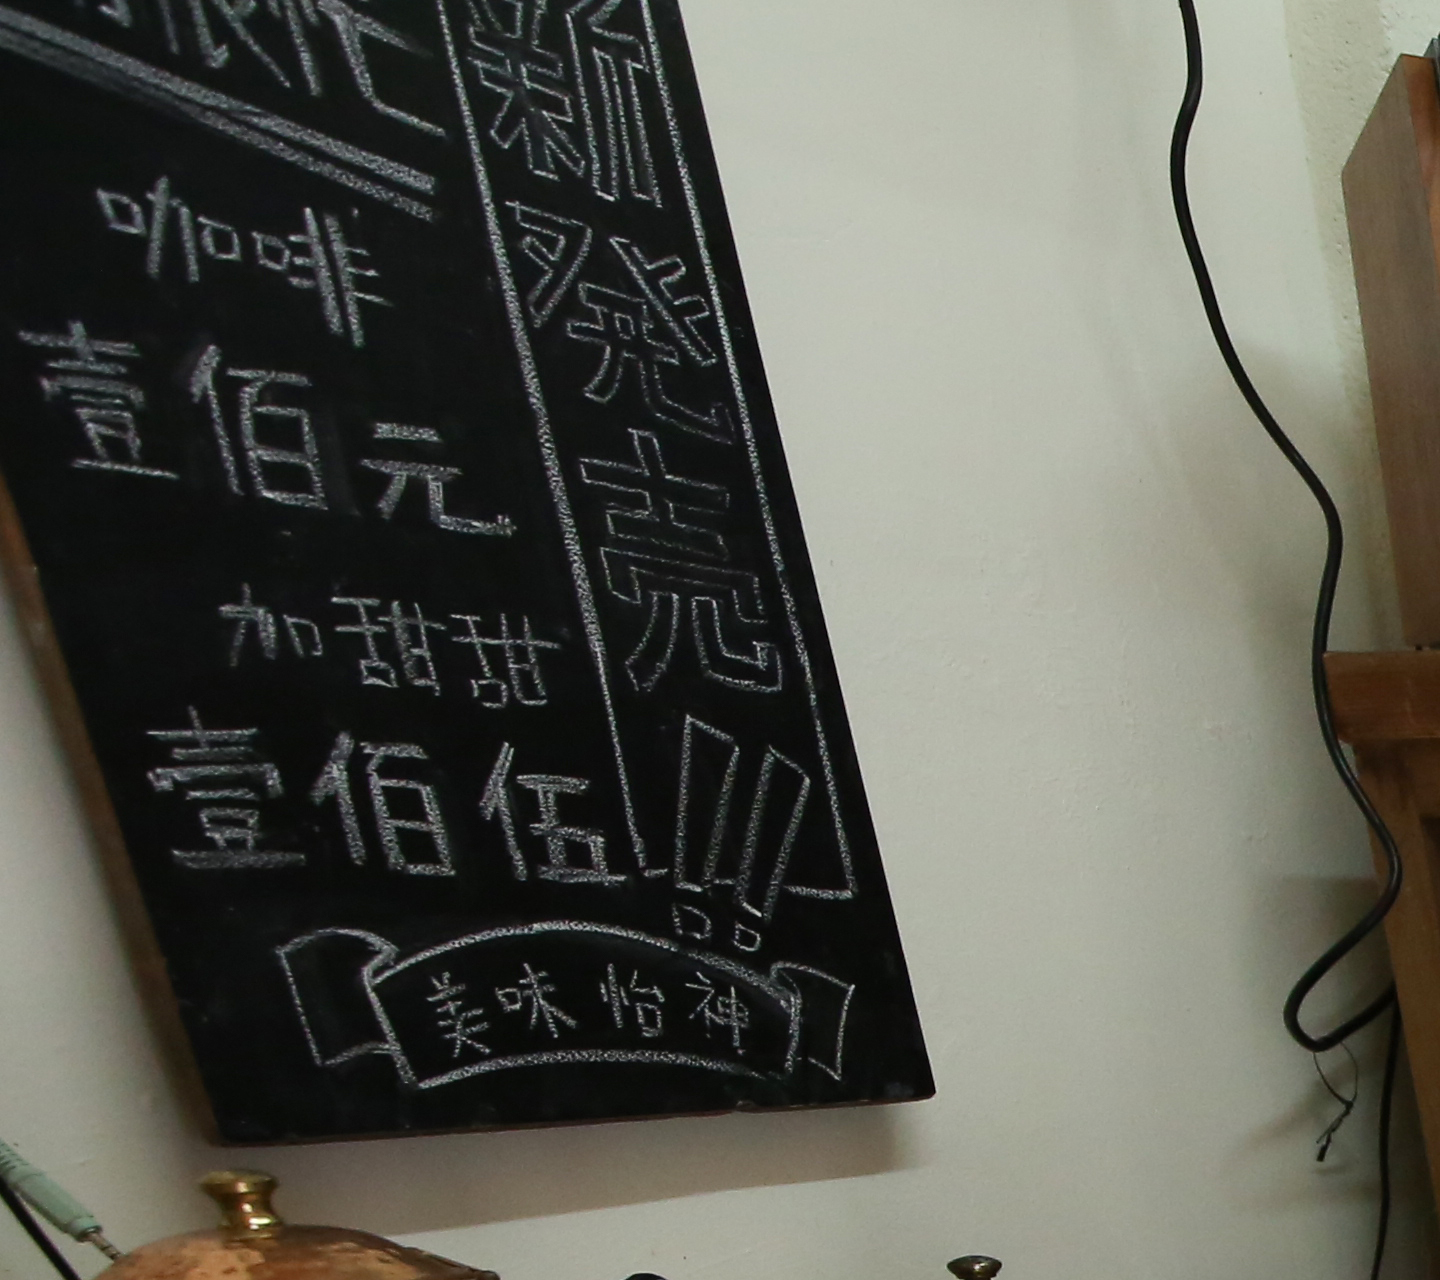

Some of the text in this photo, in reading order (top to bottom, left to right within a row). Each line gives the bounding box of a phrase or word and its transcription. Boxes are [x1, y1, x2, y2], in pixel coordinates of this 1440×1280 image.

[97, 176, 394, 347] 咖啡
[18, 319, 517, 537] 壹佰元
[218, 582, 562, 710] 加甜甜
[147, 707, 627, 885] 壹佰伍
